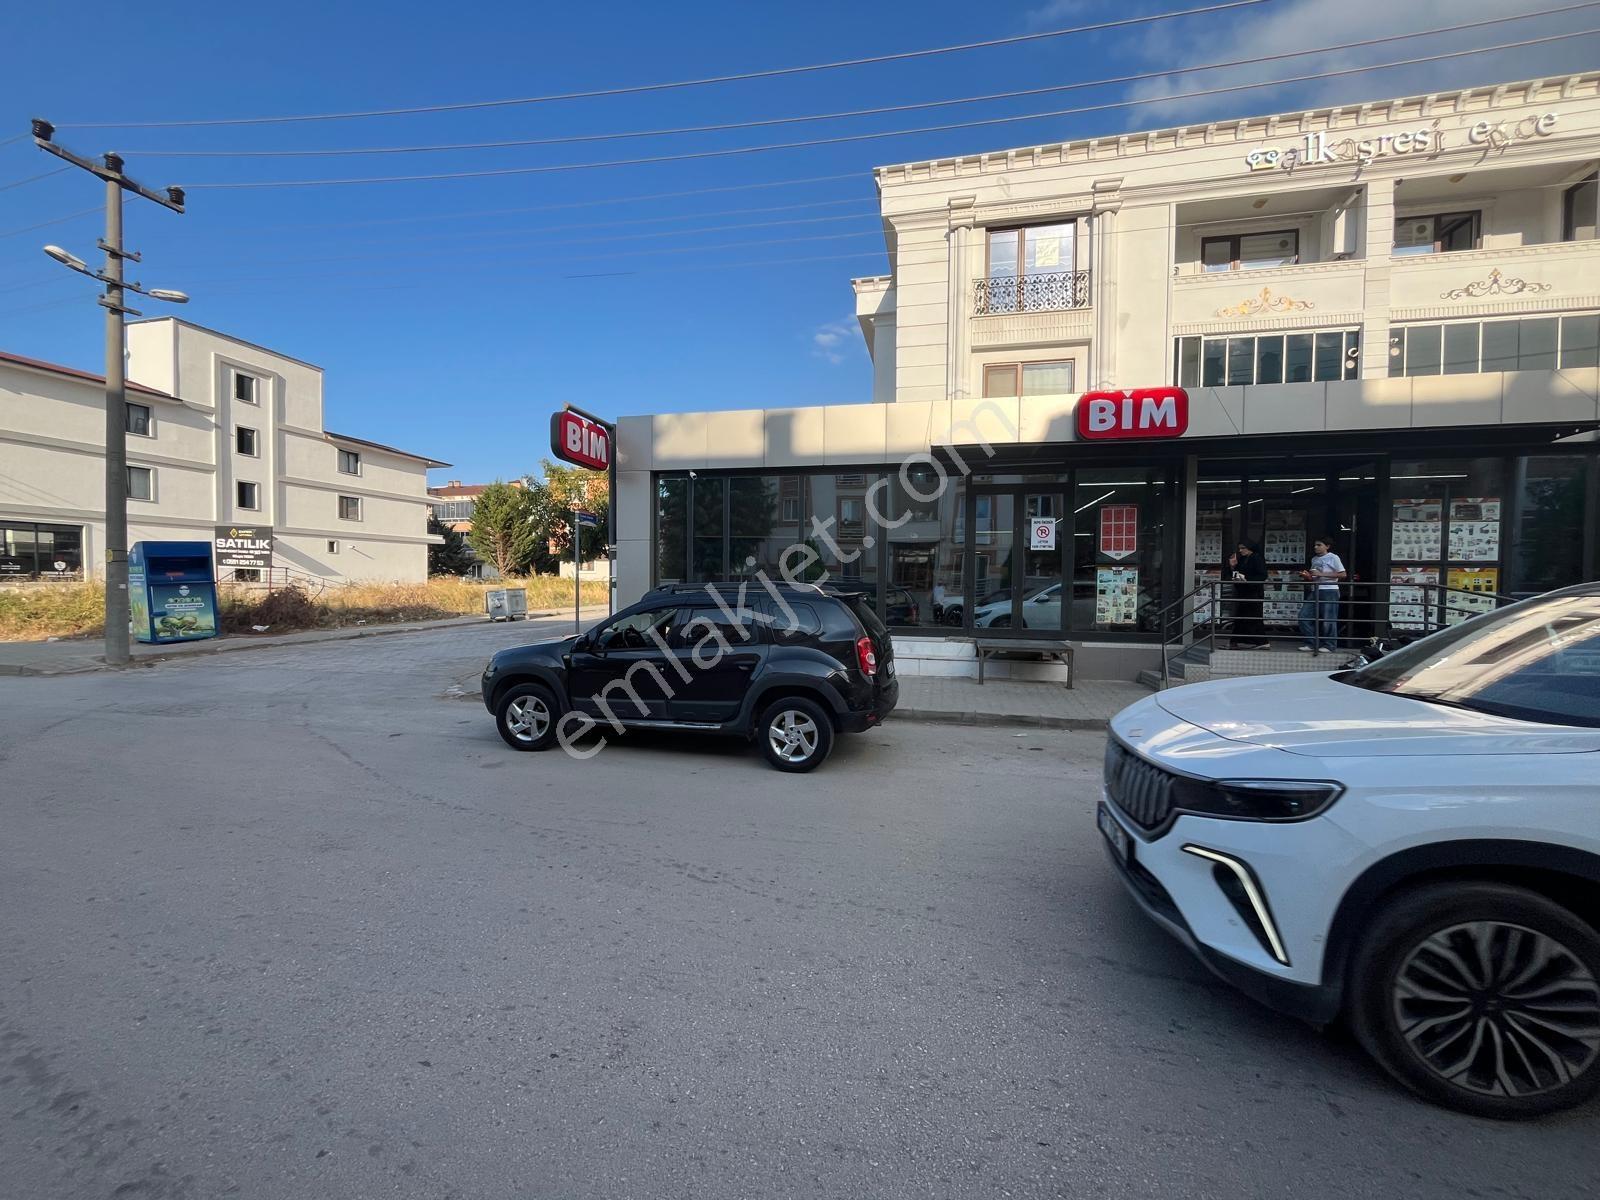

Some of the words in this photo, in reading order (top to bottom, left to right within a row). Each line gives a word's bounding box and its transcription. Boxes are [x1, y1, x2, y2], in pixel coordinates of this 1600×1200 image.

[1088, 390, 1177, 432] BİM
[567, 420, 607, 463] BİM
[216, 538, 270, 549] SATILIK
